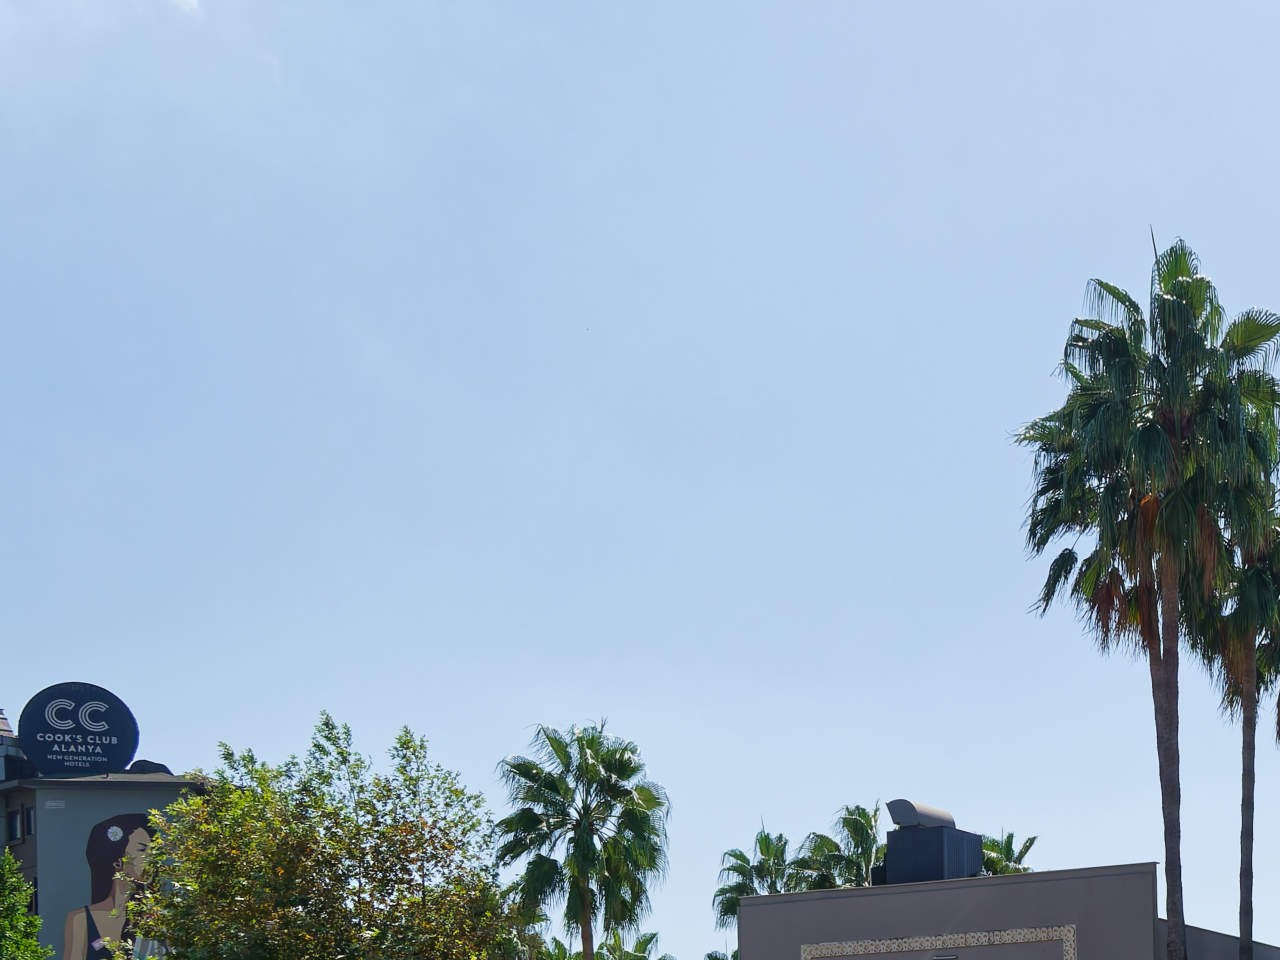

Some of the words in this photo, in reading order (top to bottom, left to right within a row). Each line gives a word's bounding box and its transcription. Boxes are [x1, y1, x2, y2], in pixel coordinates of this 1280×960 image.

[37, 733, 82, 743] COOK'S
[87, 735, 118, 745] CLUB
[52, 744, 103, 754] ALANYA
